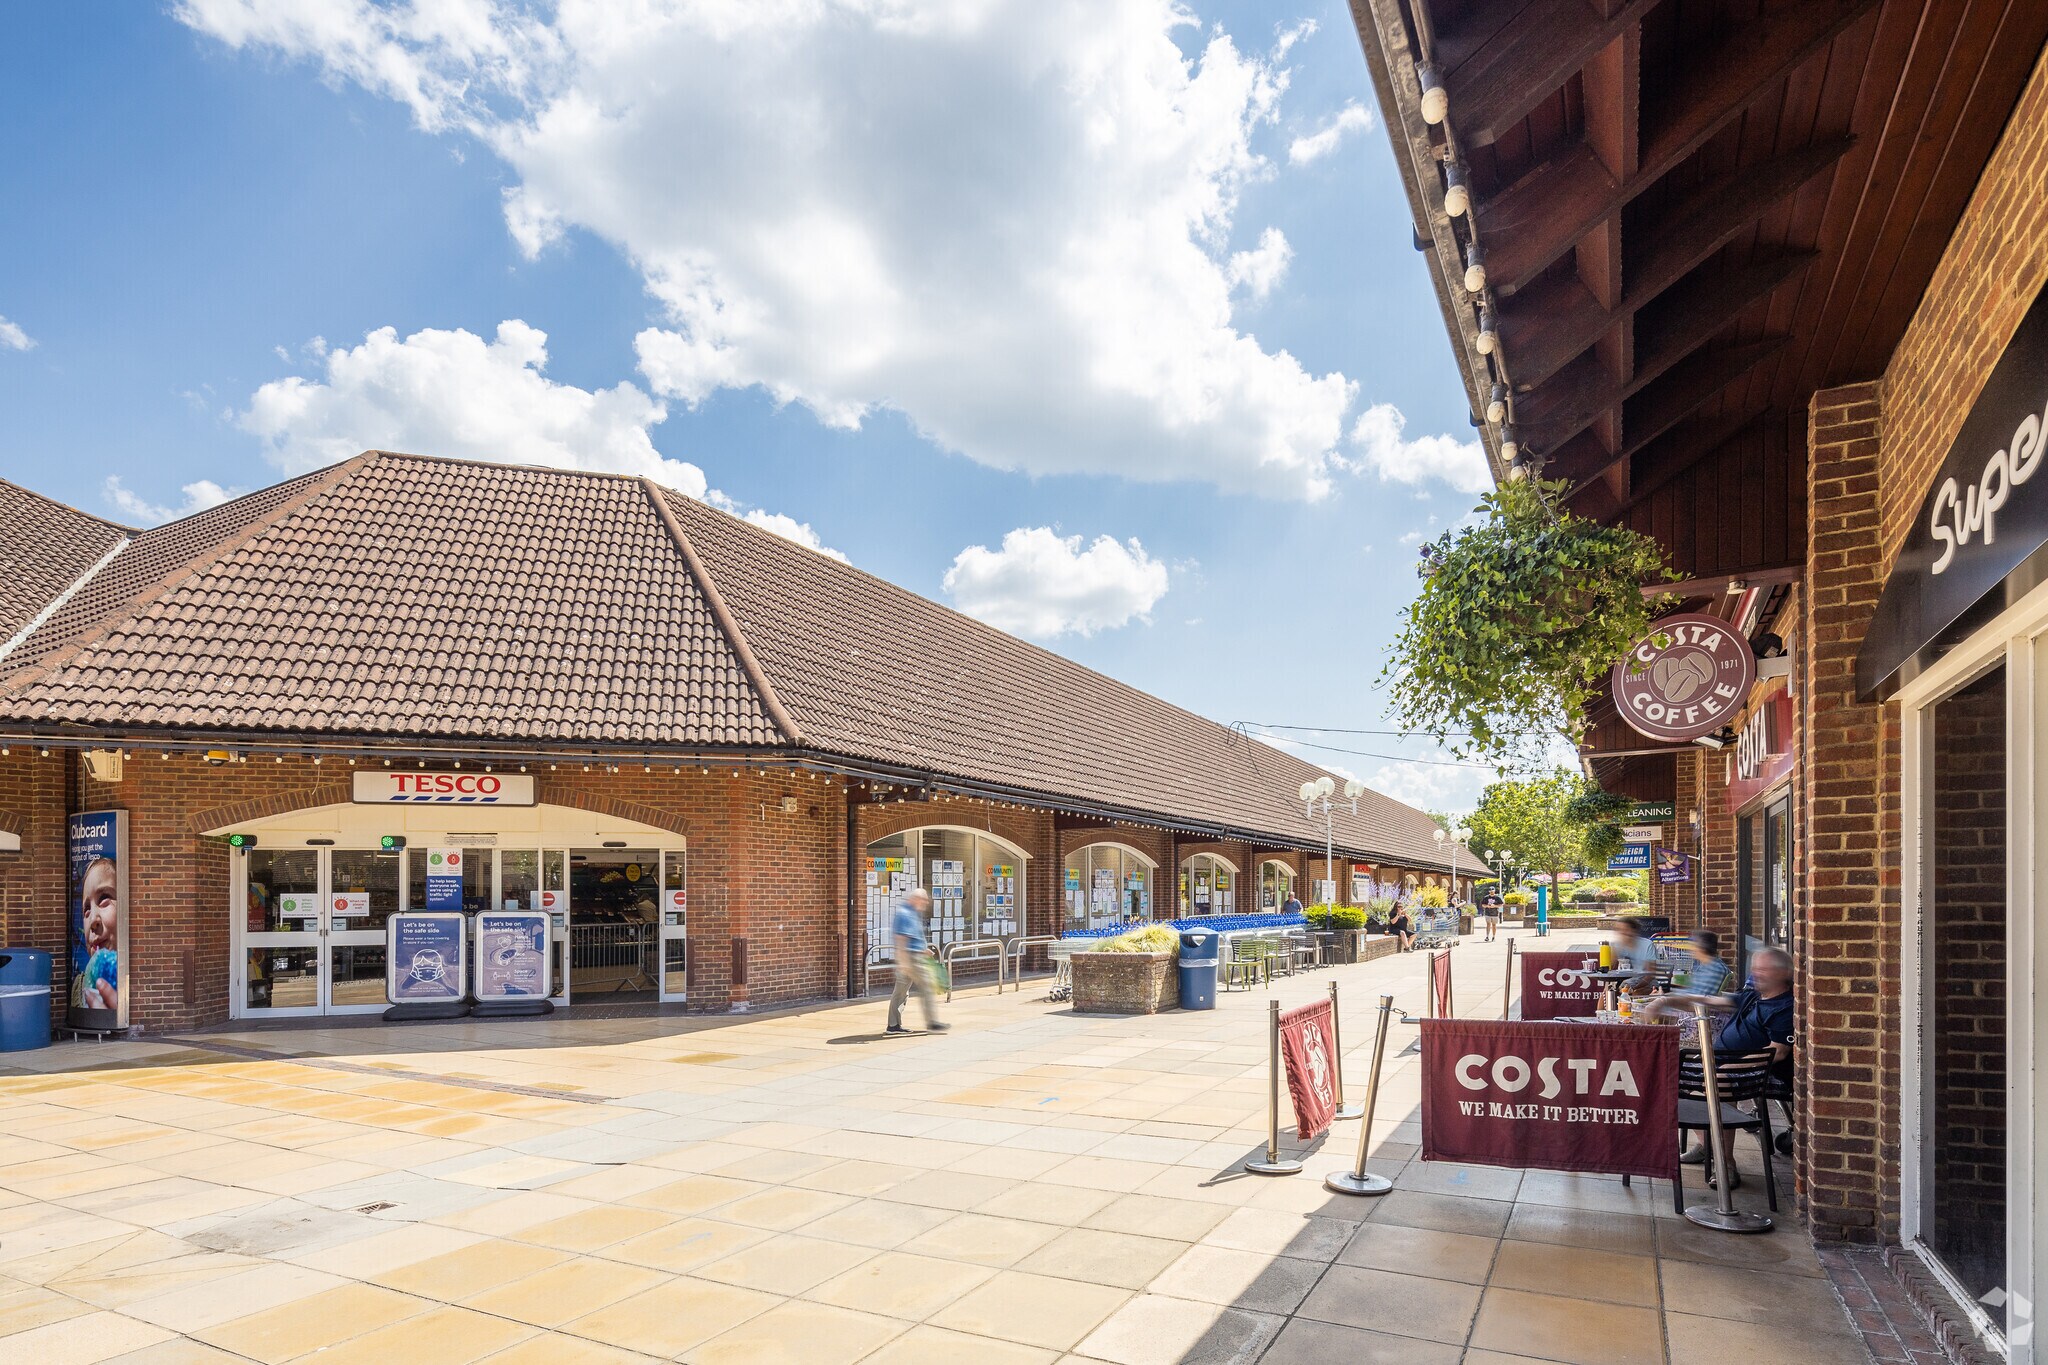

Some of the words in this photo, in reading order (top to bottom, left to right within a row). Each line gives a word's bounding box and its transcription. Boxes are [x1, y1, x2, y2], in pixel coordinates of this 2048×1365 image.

[1931, 399, 2048, 575] Supe
[1637, 626, 1722, 663] COSTA
[1625, 672, 1646, 683] SINCE
[1720, 659, 1738, 669] 1971
[1633, 682, 1737, 725] COFFEE
[390, 774, 501, 794] TESCO
[1627, 807, 1672, 817] LEANING
[71, 821, 108, 839] Clubcard
[1625, 829, 1652, 838] icians
[95, 843, 103, 851] the
[867, 860, 902, 869] COMMUNITY
[987, 867, 1012, 875] COMMUNITY
[1538, 968, 1605, 990] COS
[1539, 990, 1553, 999] WE
[1554, 991, 1580, 1000] MAKE
[1582, 991, 1592, 1000] IT
[1455, 1053, 1640, 1100] COSTA
[1458, 1100, 1485, 1117] WE
[1488, 1101, 1539, 1120] MAKE
[1543, 1105, 1562, 1122] IT
[1567, 1106, 1640, 1125] BETTER
